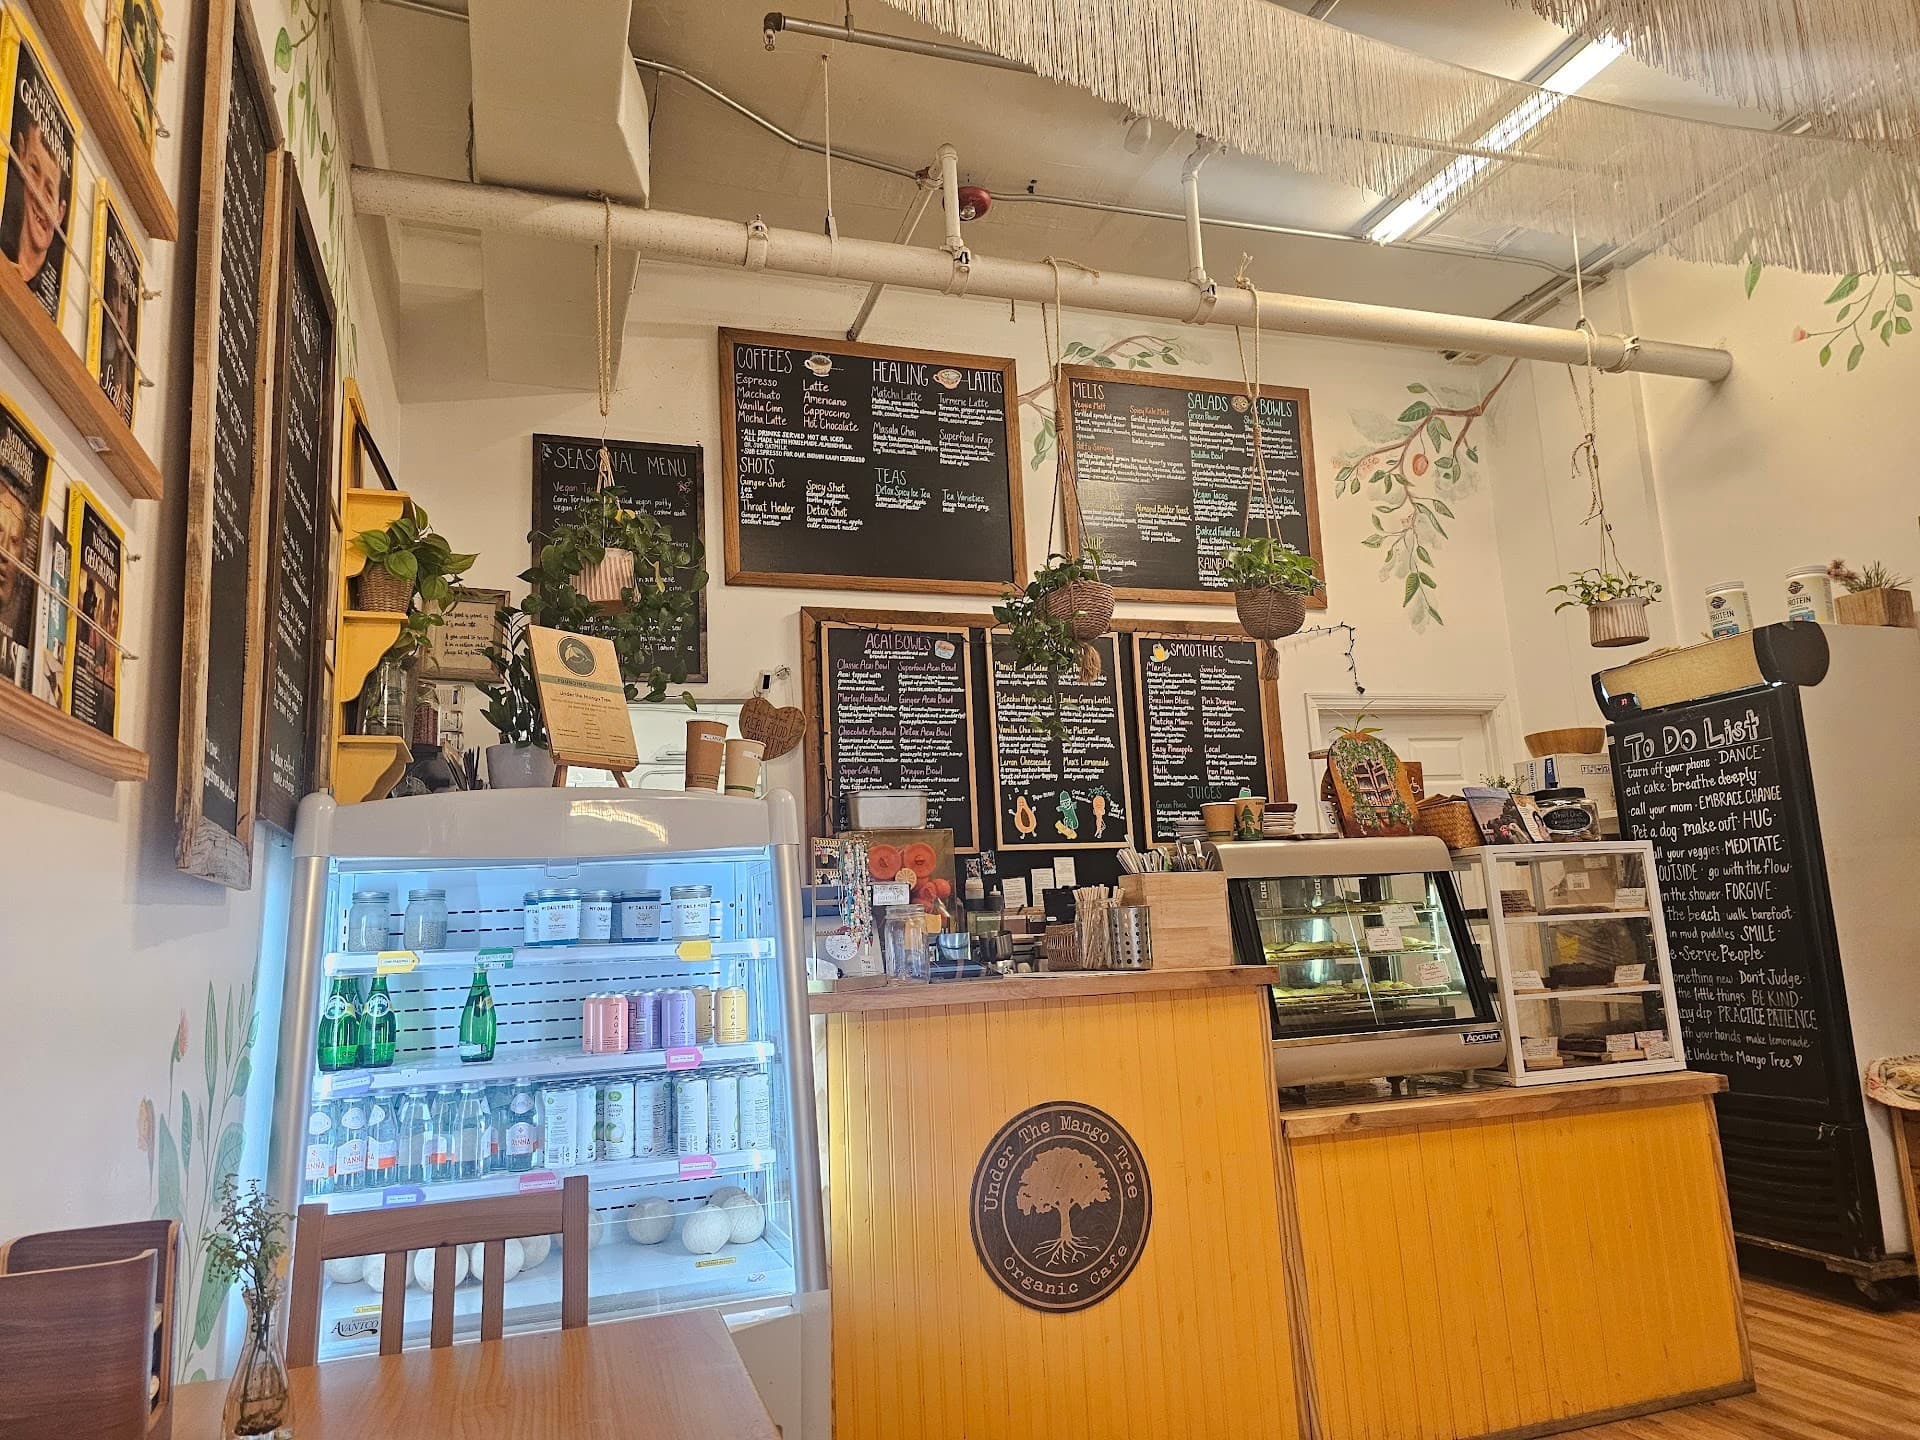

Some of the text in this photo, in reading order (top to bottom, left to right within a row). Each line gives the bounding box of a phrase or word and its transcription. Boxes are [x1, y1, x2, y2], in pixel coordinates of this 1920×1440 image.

[34, 76, 65, 145] NATIONAL
[20, 79, 72, 179] GEOGRAPHIC
[736, 346, 793, 374] COFFEES
[735, 372, 778, 388] Espresso
[802, 379, 830, 392] Latte
[872, 360, 1003, 394] HEALING LATTES
[736, 386, 781, 400] Macchiato
[803, 391, 847, 407] Americano
[871, 386, 923, 402] Matcha Latte
[1072, 381, 1105, 400] MELTS
[737, 399, 765, 412] Vanilla
[968, 397, 990, 408] Latte
[1187, 392, 1293, 417] SALADS BOWLS
[737, 409, 788, 426] Mocha Latte
[803, 404, 851, 419] Cappuccino
[803, 416, 859, 432] Hot Chocolate
[872, 421, 917, 438] Masala Chai
[781, 431, 805, 439] SERVED
[939, 429, 993, 450] Superfood Frap
[647, 456, 687, 478] MENU
[740, 456, 775, 475] SHOTS
[740, 474, 786, 490] Ginger Shot
[874, 467, 906, 486] TEAS
[552, 481, 578, 496] Vegan
[806, 480, 846, 493] Spicy Shot
[942, 488, 954, 501] Tea
[740, 499, 795, 514] Throat Healer
[807, 503, 848, 517] Detox Shot
[1195, 524, 1218, 536] Baked
[92, 530, 116, 567] NATIONAL
[84, 546, 118, 592] GEOGRAPHIC
[864, 633, 932, 651] ACAI BOWLS
[1170, 642, 1224, 659] SMOOTHIES
[1146, 661, 1171, 673] Marley
[938, 695, 954, 704] Bowl
[1201, 696, 1236, 706] Pink Dragon
[1202, 718, 1236, 726] Choco Loco
[1624, 709, 1759, 763] To Do List
[1204, 744, 1221, 753] Local
[1153, 765, 1169, 774] Hulk
[1626, 745, 1761, 779] turn off your phone DANCE
[900, 764, 943, 778] Dragon Bowl
[1625, 766, 1758, 797] eat cake breathe deeply
[1187, 786, 1222, 800] JUICES
[1630, 785, 1782, 820] call your mom EMBRACE CHANGE
[1631, 808, 1773, 842] Pet a dog make out HUG
[1667, 847, 1685, 863] your
[1687, 845, 1721, 861] veggies
[1724, 834, 1782, 855] MEDITATE
[1658, 858, 1790, 882] OUTSIDE go with the flow
[1670, 881, 1774, 902] the shower FORGIVE
[1666, 905, 1793, 922] the beach walk barefoot
[1669, 925, 1777, 945] in mud puddles SMILE
[1681, 944, 1764, 965] Serve People
[1673, 967, 1803, 989] omething new Don't Judge
[1678, 988, 1800, 1008] the little things BE KIND
[1695, 1003, 1818, 1030] dip PRACTICE PATIENCE
[1695, 1027, 1810, 1049] your hands make lemonade
[1694, 1048, 1793, 1070] Under the Mango Tree
[983, 1115, 1138, 1213] Under The Mango Tree
[1003, 1244, 1128, 1296] Organic Cafe
[330, 1319, 379, 1335] AVANTCO
